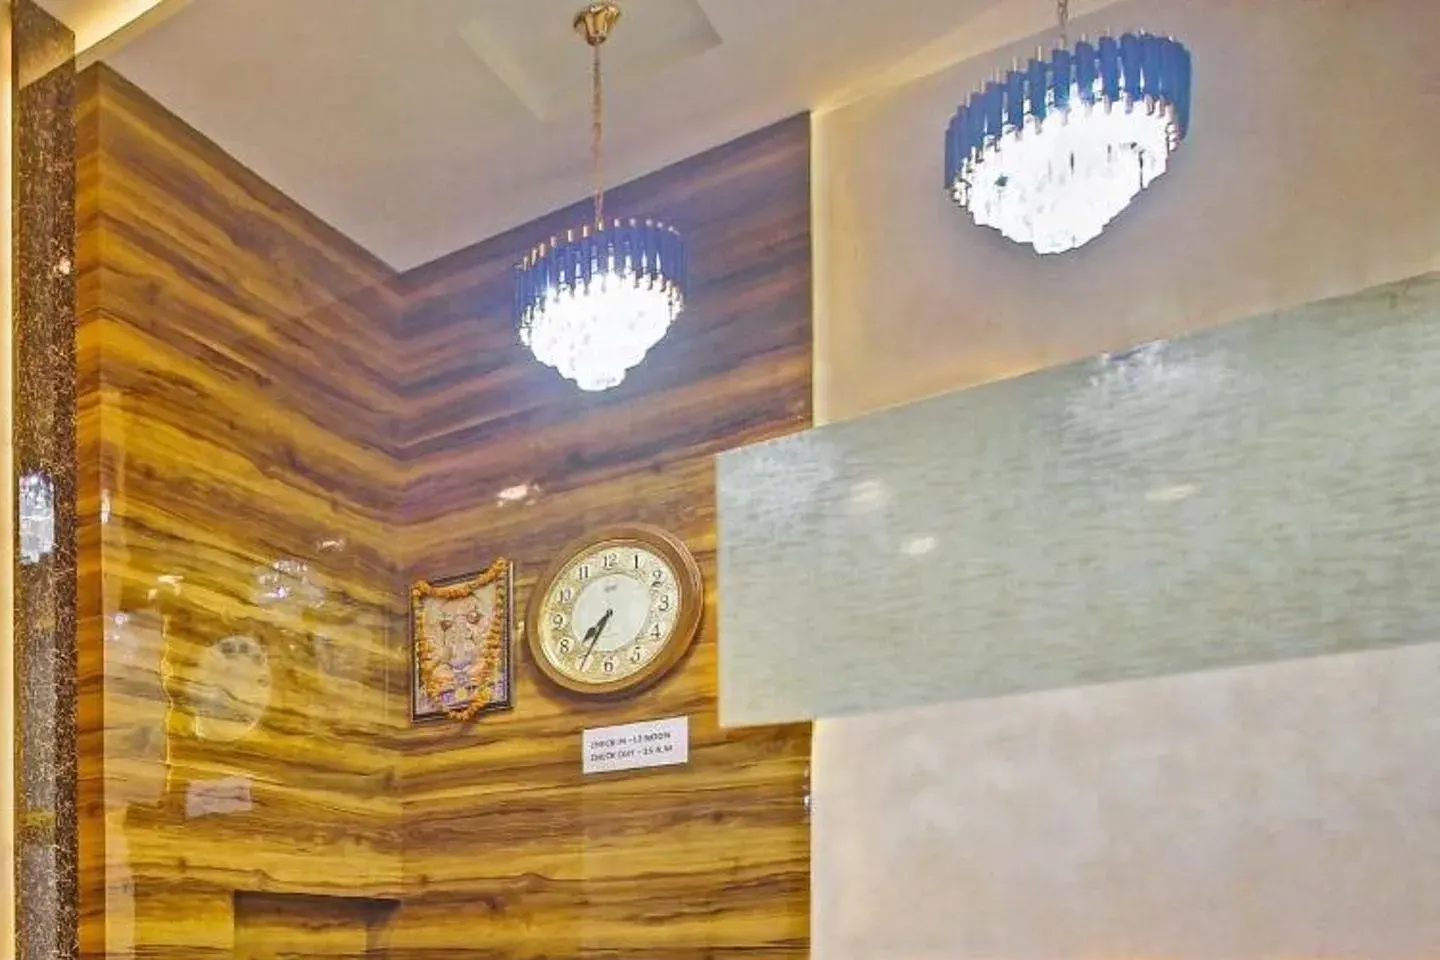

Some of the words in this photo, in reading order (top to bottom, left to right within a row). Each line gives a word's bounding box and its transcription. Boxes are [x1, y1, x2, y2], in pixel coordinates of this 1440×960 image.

[603, 552, 618, 569] 12
[633, 554, 639, 568] 1
[578, 566, 590, 580] 11
[652, 569, 662, 588] 2
[658, 594, 669, 612] 3
[552, 613, 564, 628] 9
[650, 623, 661, 638] 4
[559, 638, 570, 653] 8
[630, 646, 641, 663] 5
[603, 657, 614, 672] 6
